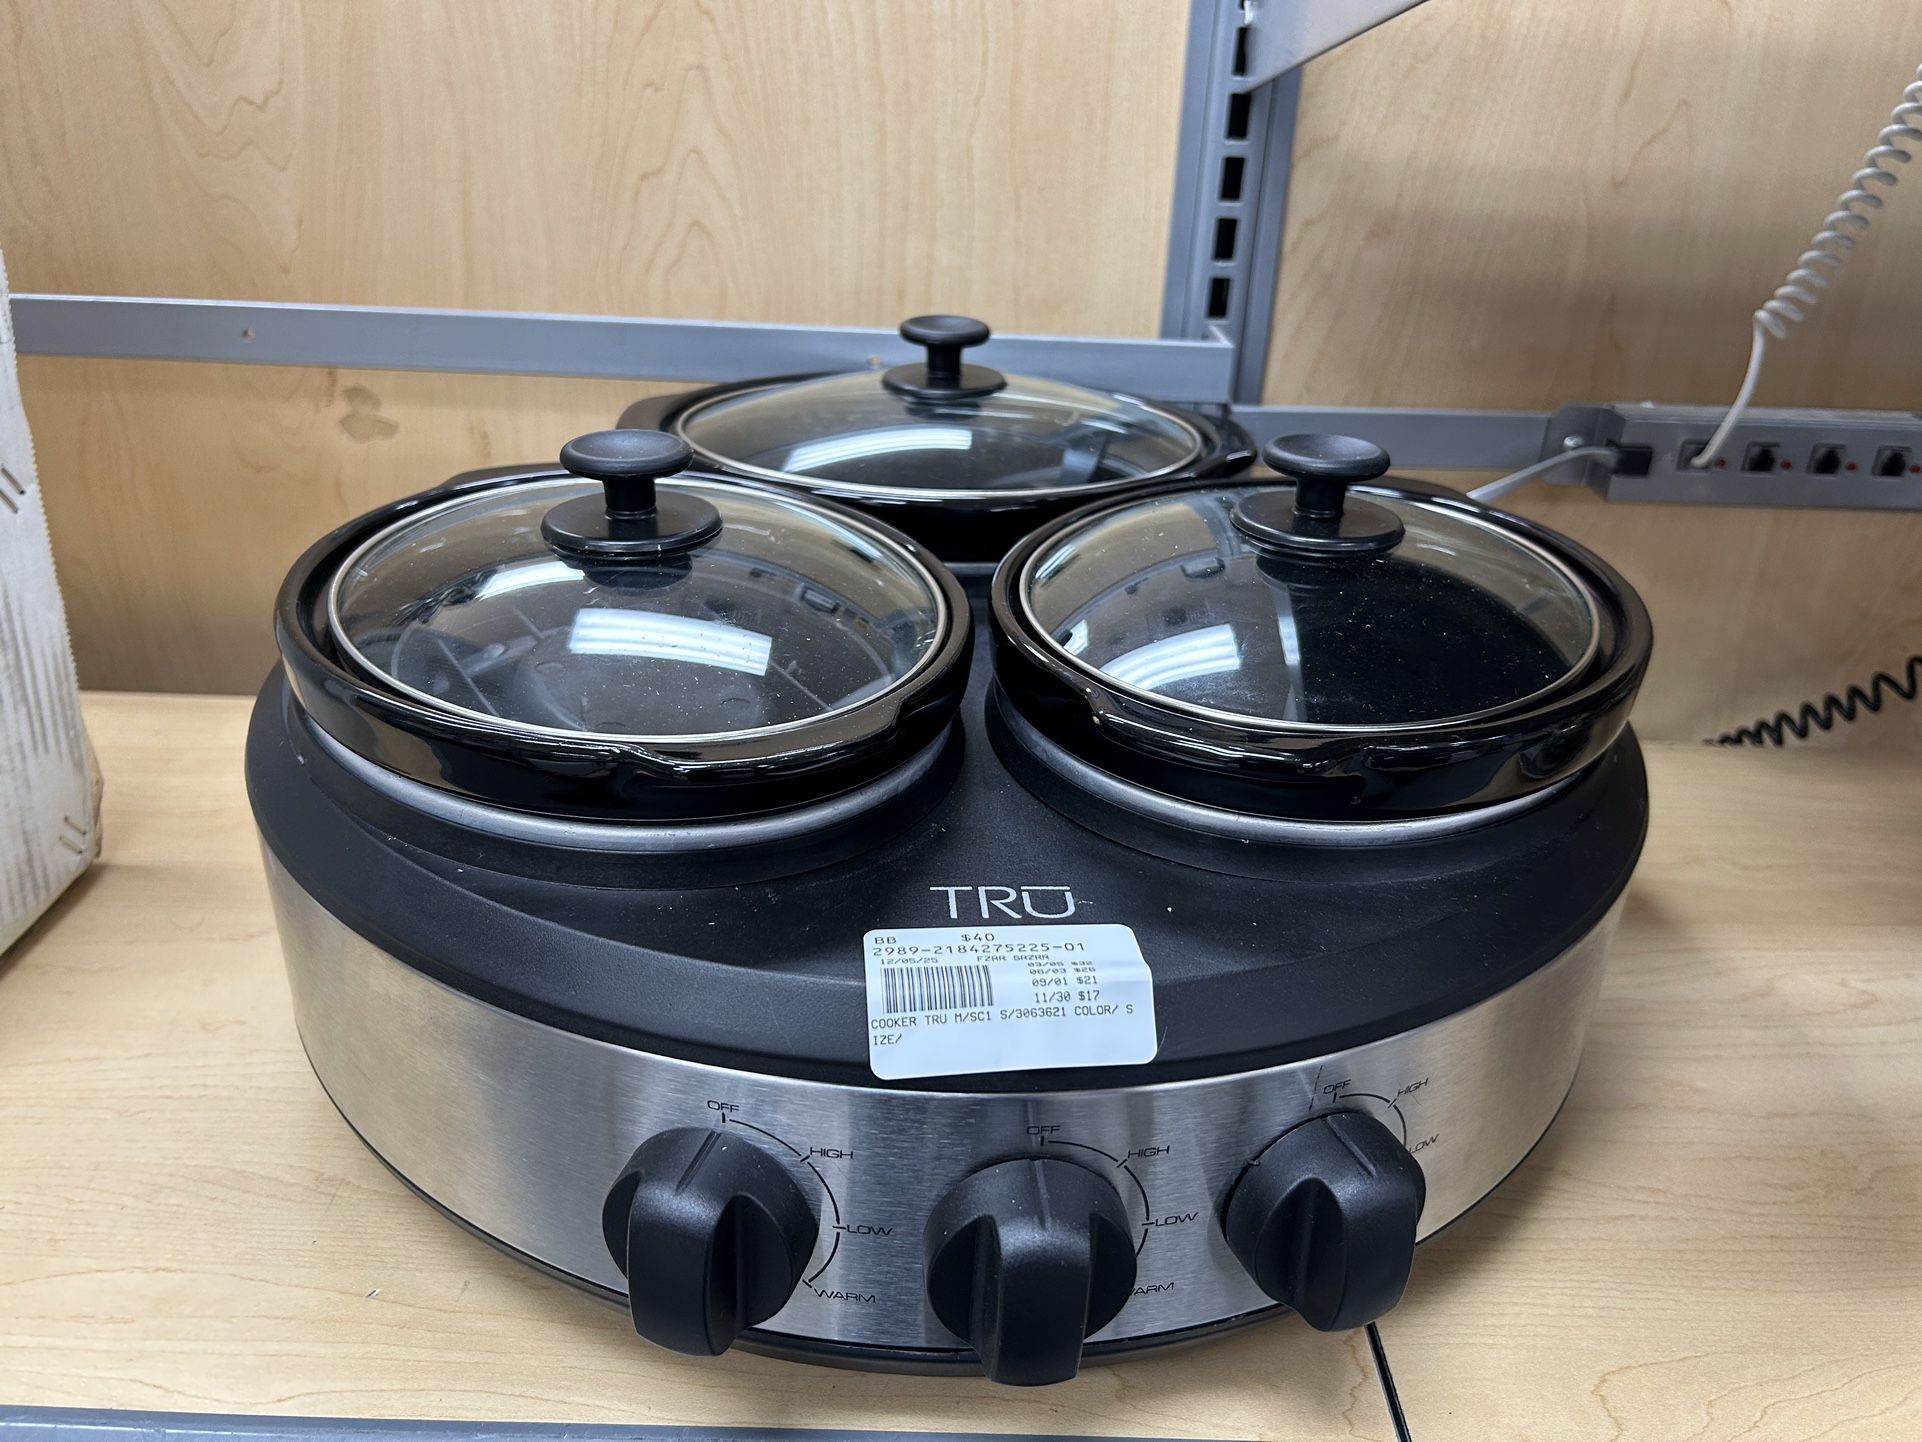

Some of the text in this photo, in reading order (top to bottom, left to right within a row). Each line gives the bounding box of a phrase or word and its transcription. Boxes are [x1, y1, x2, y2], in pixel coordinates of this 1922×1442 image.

[874, 932, 996, 945] BB $40
[872, 942, 1085, 957] 2989-2184275225-01
[1031, 975, 1099, 988] 09/01 $21
[1034, 989, 1101, 1004] 11/30 $17
[870, 1003, 1134, 1030] COOKER TRU M/SC1 S/3063621 COLOR/ S
[873, 1032, 903, 1046] IZE/
[1322, 1078, 1352, 1095] OFF
[1396, 1077, 1430, 1097] HIGH
[706, 1099, 740, 1113] OFF
[1026, 1124, 1061, 1136] OFF
[809, 1146, 854, 1160] HIGH
[1127, 1145, 1170, 1159] HIGH
[1155, 1211, 1199, 1228] LOW
[846, 1224, 893, 1236] LOW
[814, 1287, 876, 1304] WARM
[1129, 1282, 1175, 1297] ARM
